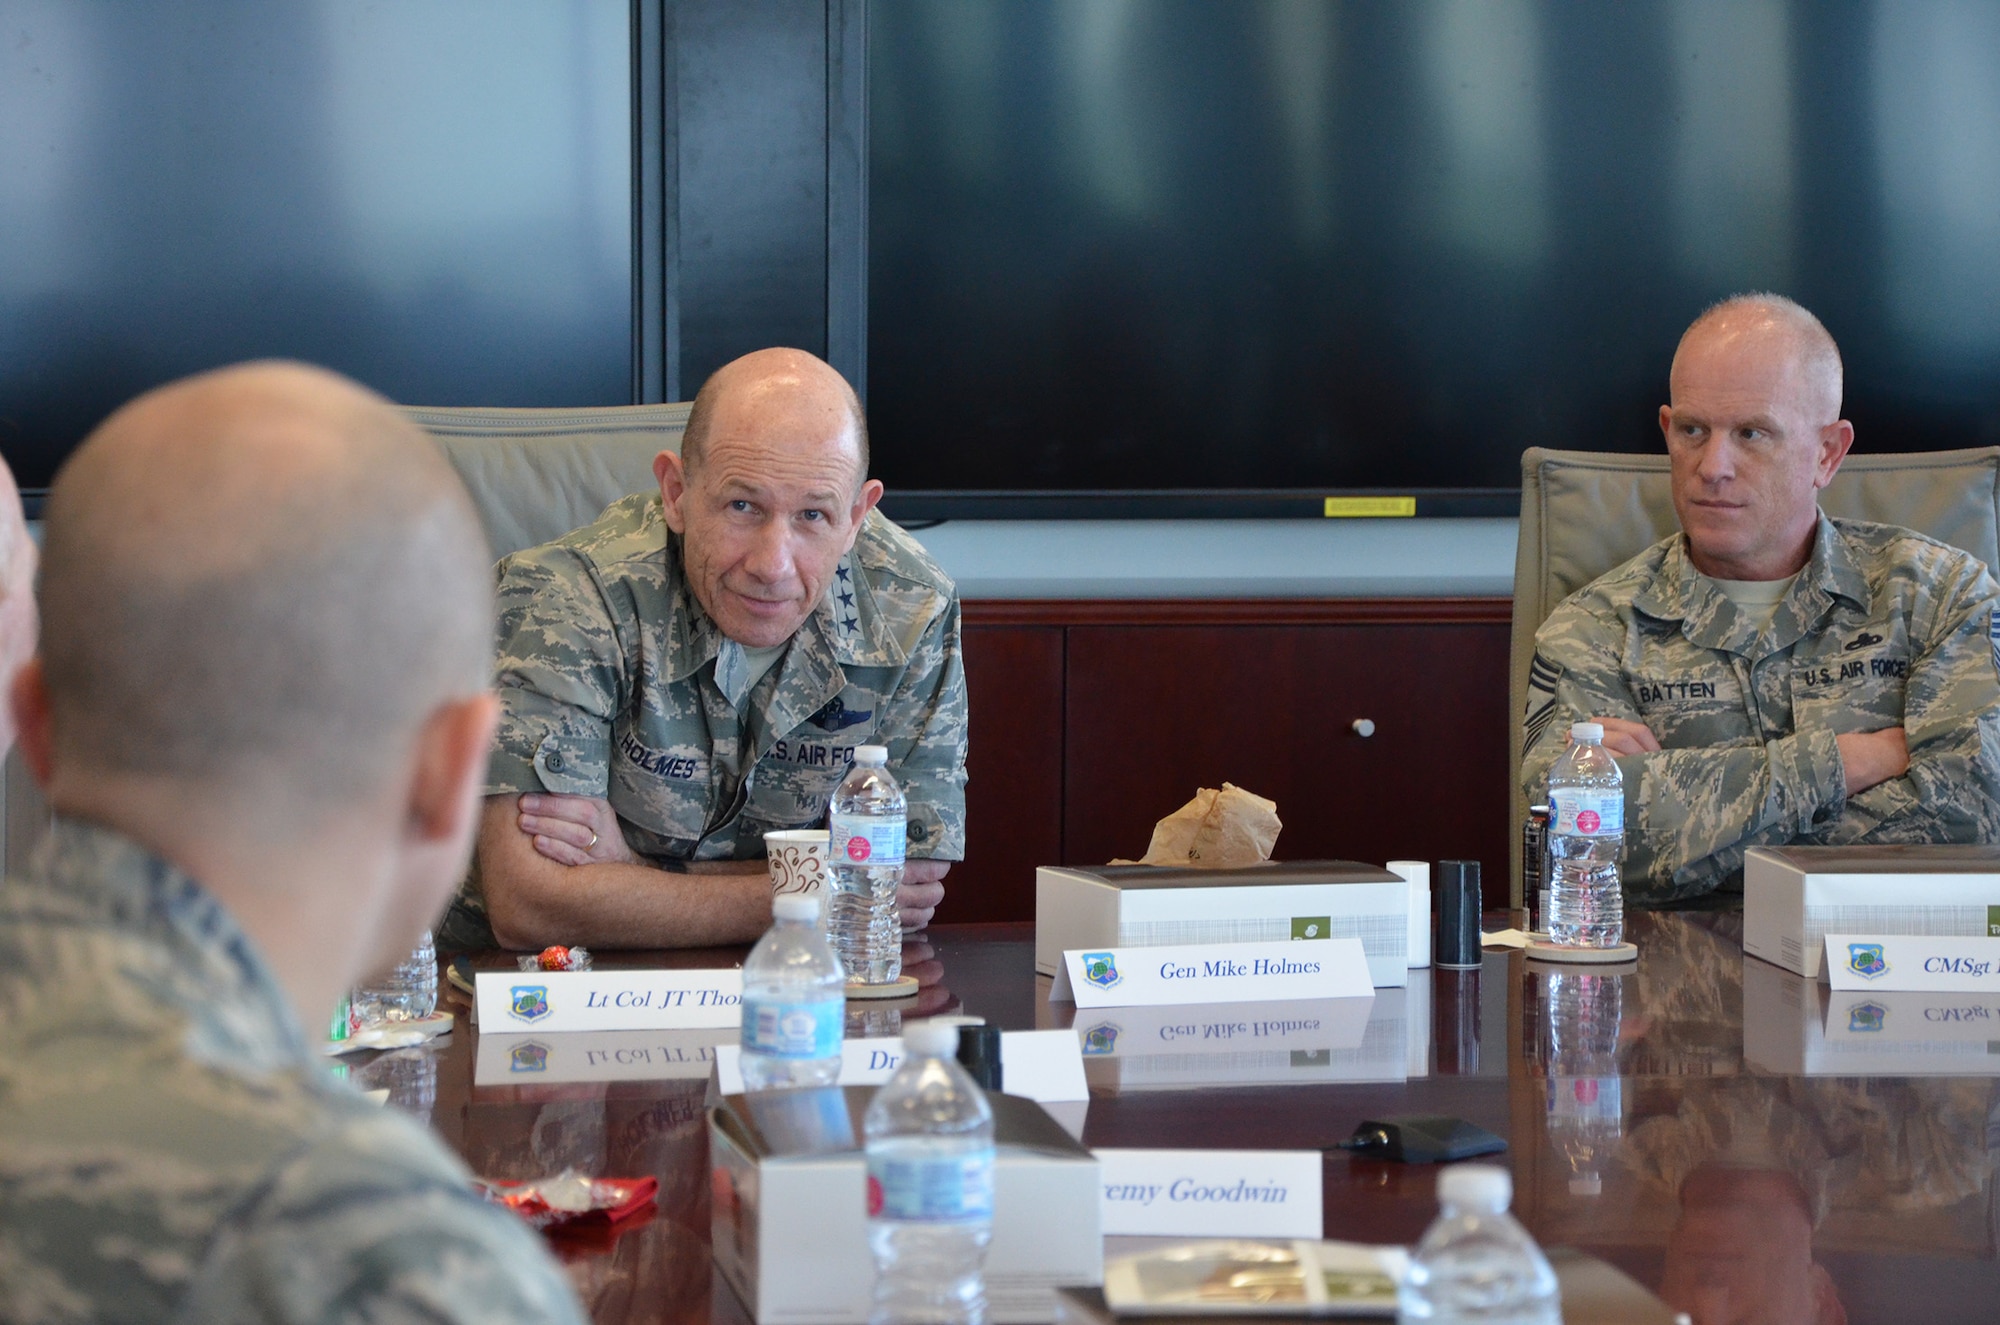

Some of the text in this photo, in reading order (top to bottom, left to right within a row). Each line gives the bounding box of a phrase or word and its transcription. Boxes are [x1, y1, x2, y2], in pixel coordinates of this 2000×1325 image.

[1804, 658, 1907, 687] U.S. AIR FORCE
[1639, 681, 1716, 702] BATTEN
[620, 731, 697, 779] HOLMES
[797, 743, 827, 766] AIR
[831, 746, 856, 767] FO
[1159, 957, 1321, 980] Gen Mike Holmes
[1923, 956, 1992, 978] CMSgt
[586, 991, 610, 1008] Lt
[615, 990, 652, 1008] Col
[657, 989, 692, 1010] JT
[868, 1050, 900, 1071] Dr
[1103, 1177, 1288, 1207] emy Goodwin
